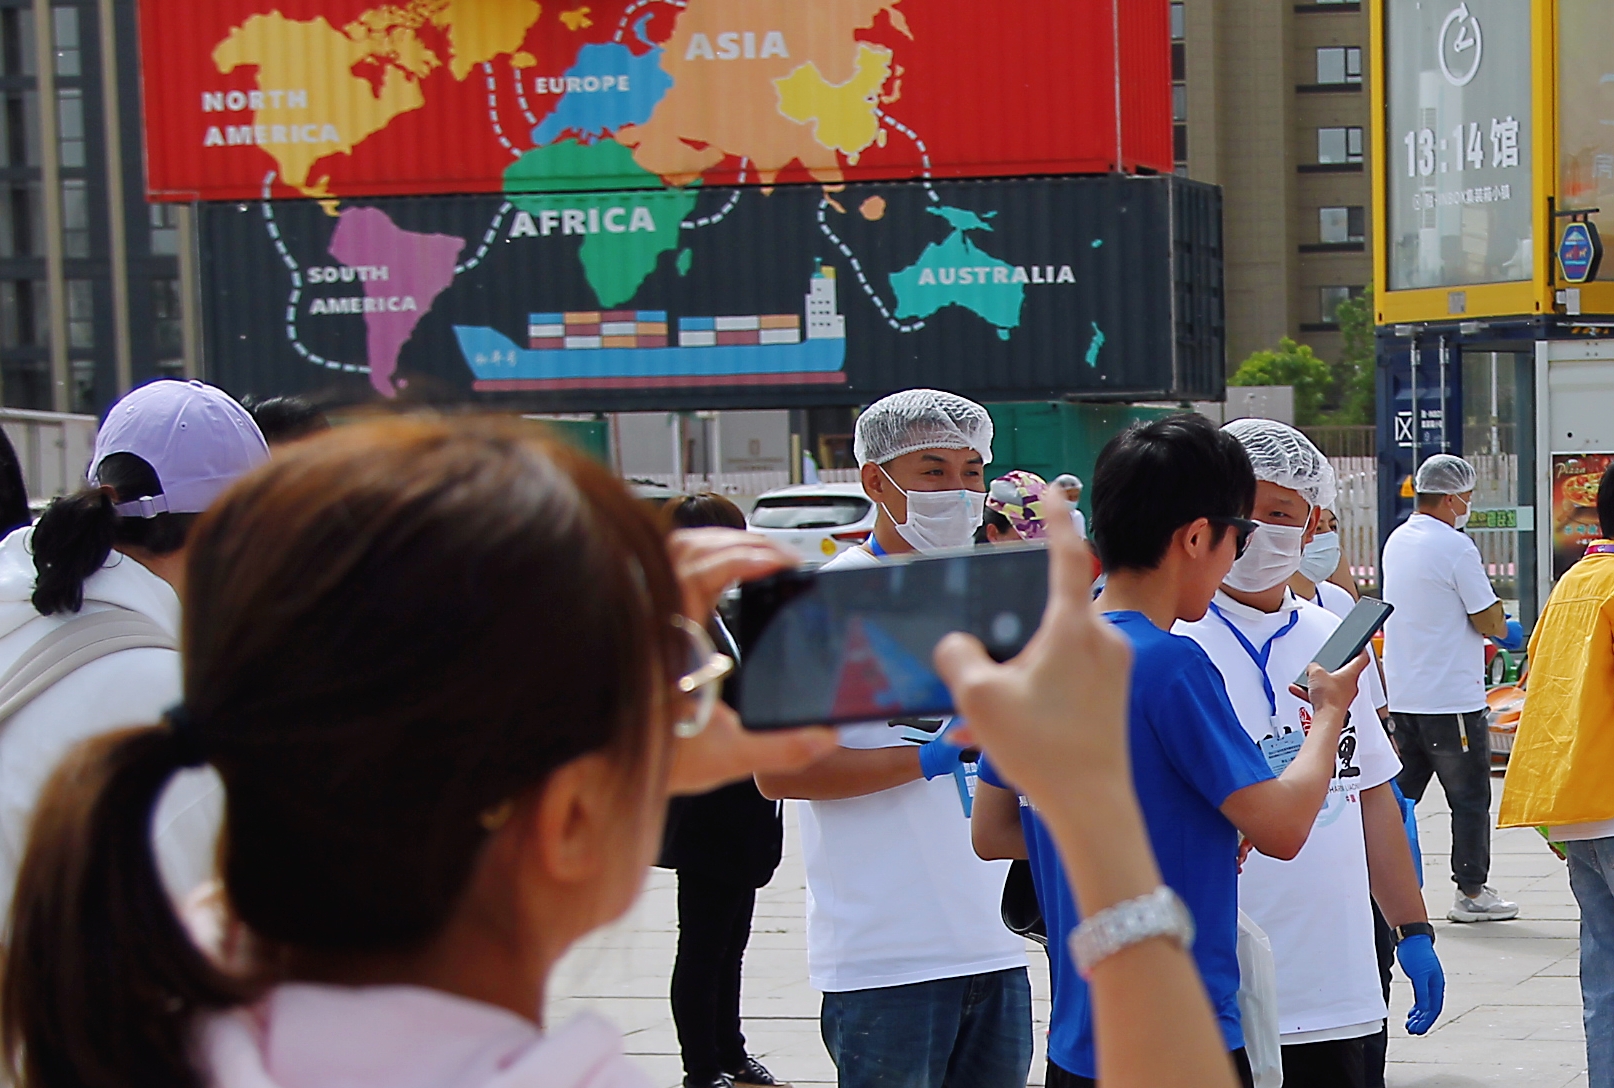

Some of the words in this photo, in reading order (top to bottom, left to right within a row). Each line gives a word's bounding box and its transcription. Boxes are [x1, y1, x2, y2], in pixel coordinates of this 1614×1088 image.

[686, 31, 789, 60] ASIA
[535, 75, 630, 95] EUROPE
[202, 90, 307, 112] NORTH
[204, 124, 340, 147] AMERICA
[509, 207, 656, 238] AFRICA
[308, 266, 389, 284] SOUTH
[918, 265, 1076, 286] AUSTRALIA
[310, 296, 418, 315] AMERICA
[1555, 462, 1586, 478] Pizza
